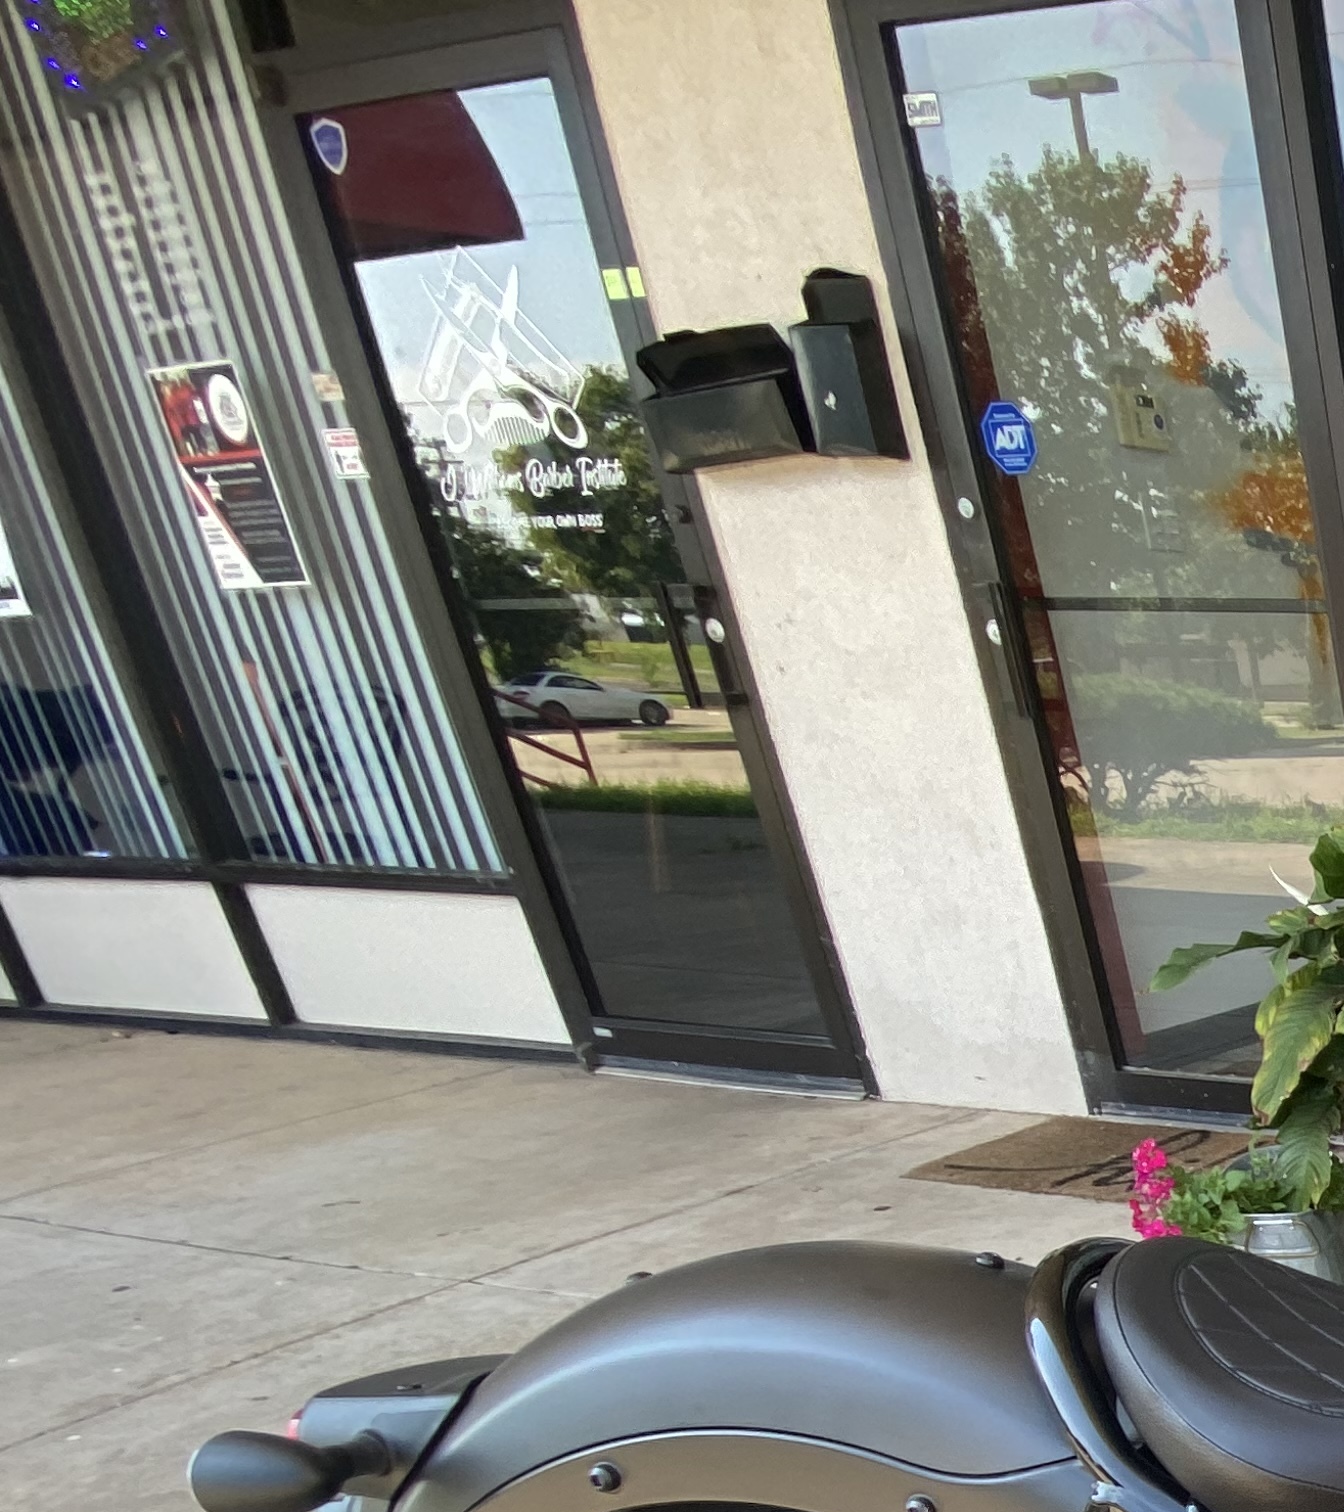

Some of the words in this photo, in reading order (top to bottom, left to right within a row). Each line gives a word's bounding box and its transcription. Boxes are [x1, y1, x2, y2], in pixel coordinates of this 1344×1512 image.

[995, 425, 1026, 450] ADT
[532, 514, 557, 529] YOUR
[578, 514, 603, 527] BOSS
